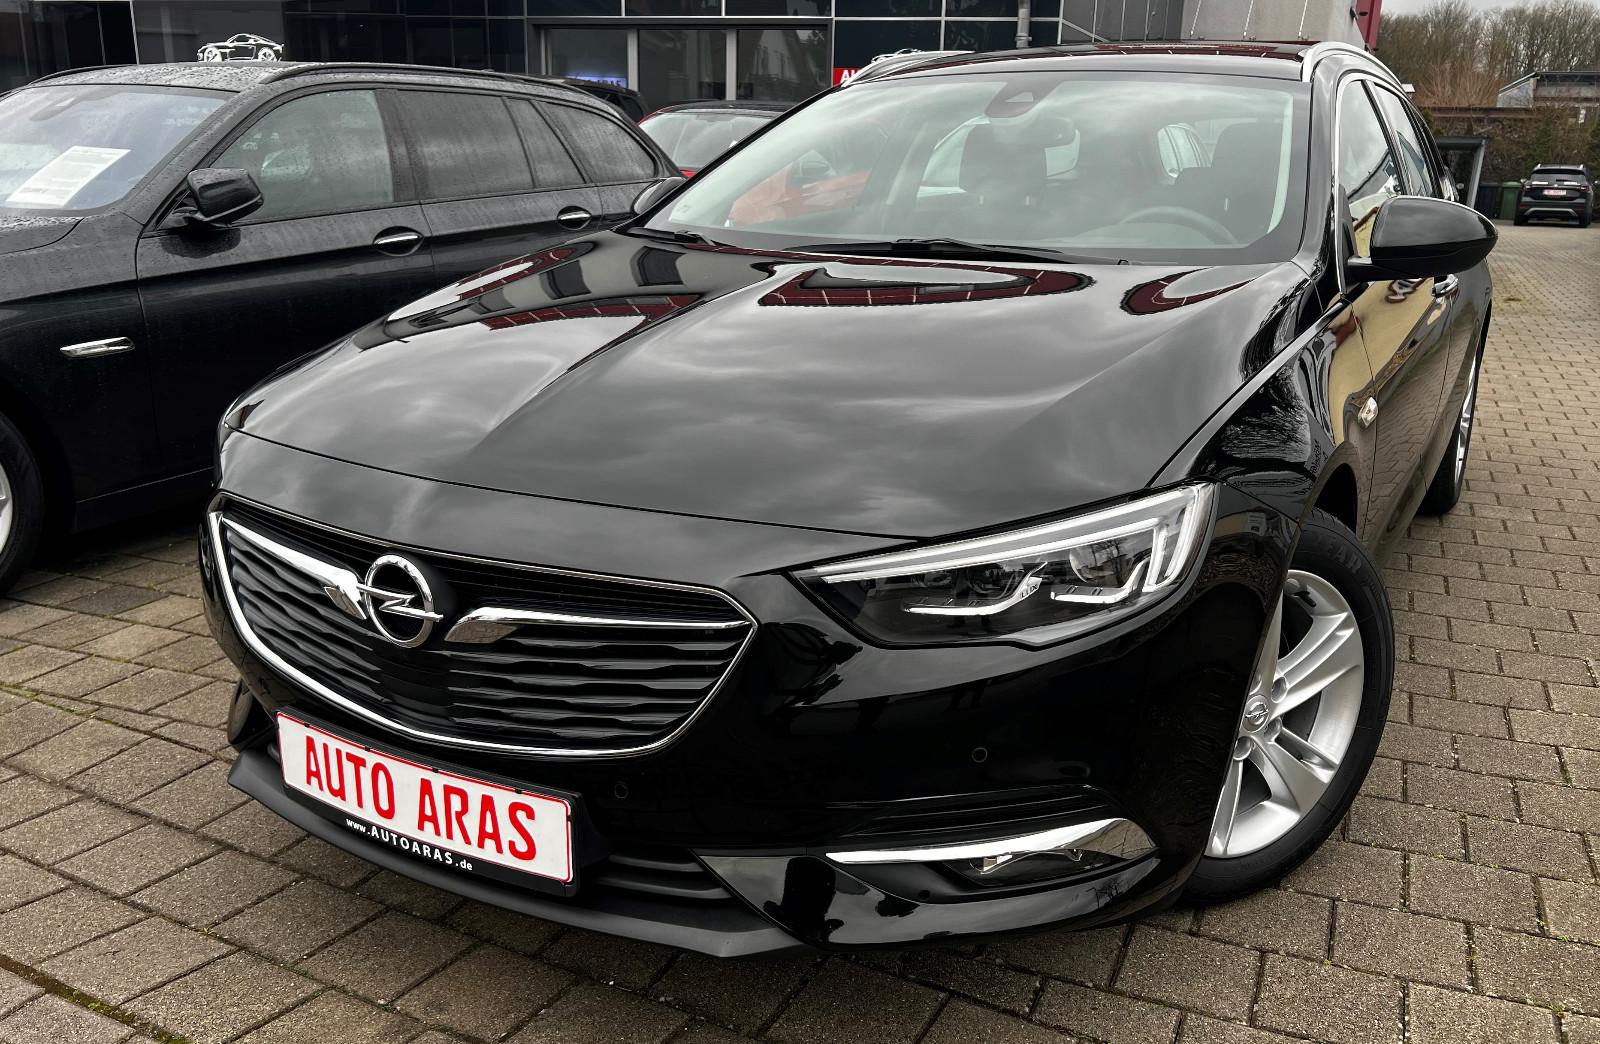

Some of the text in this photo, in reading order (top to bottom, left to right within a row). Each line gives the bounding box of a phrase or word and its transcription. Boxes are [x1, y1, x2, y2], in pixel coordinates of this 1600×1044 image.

[305, 735, 537, 861] AUTO ARAS
[346, 818, 473, 871] www.AUTOARAS.de
